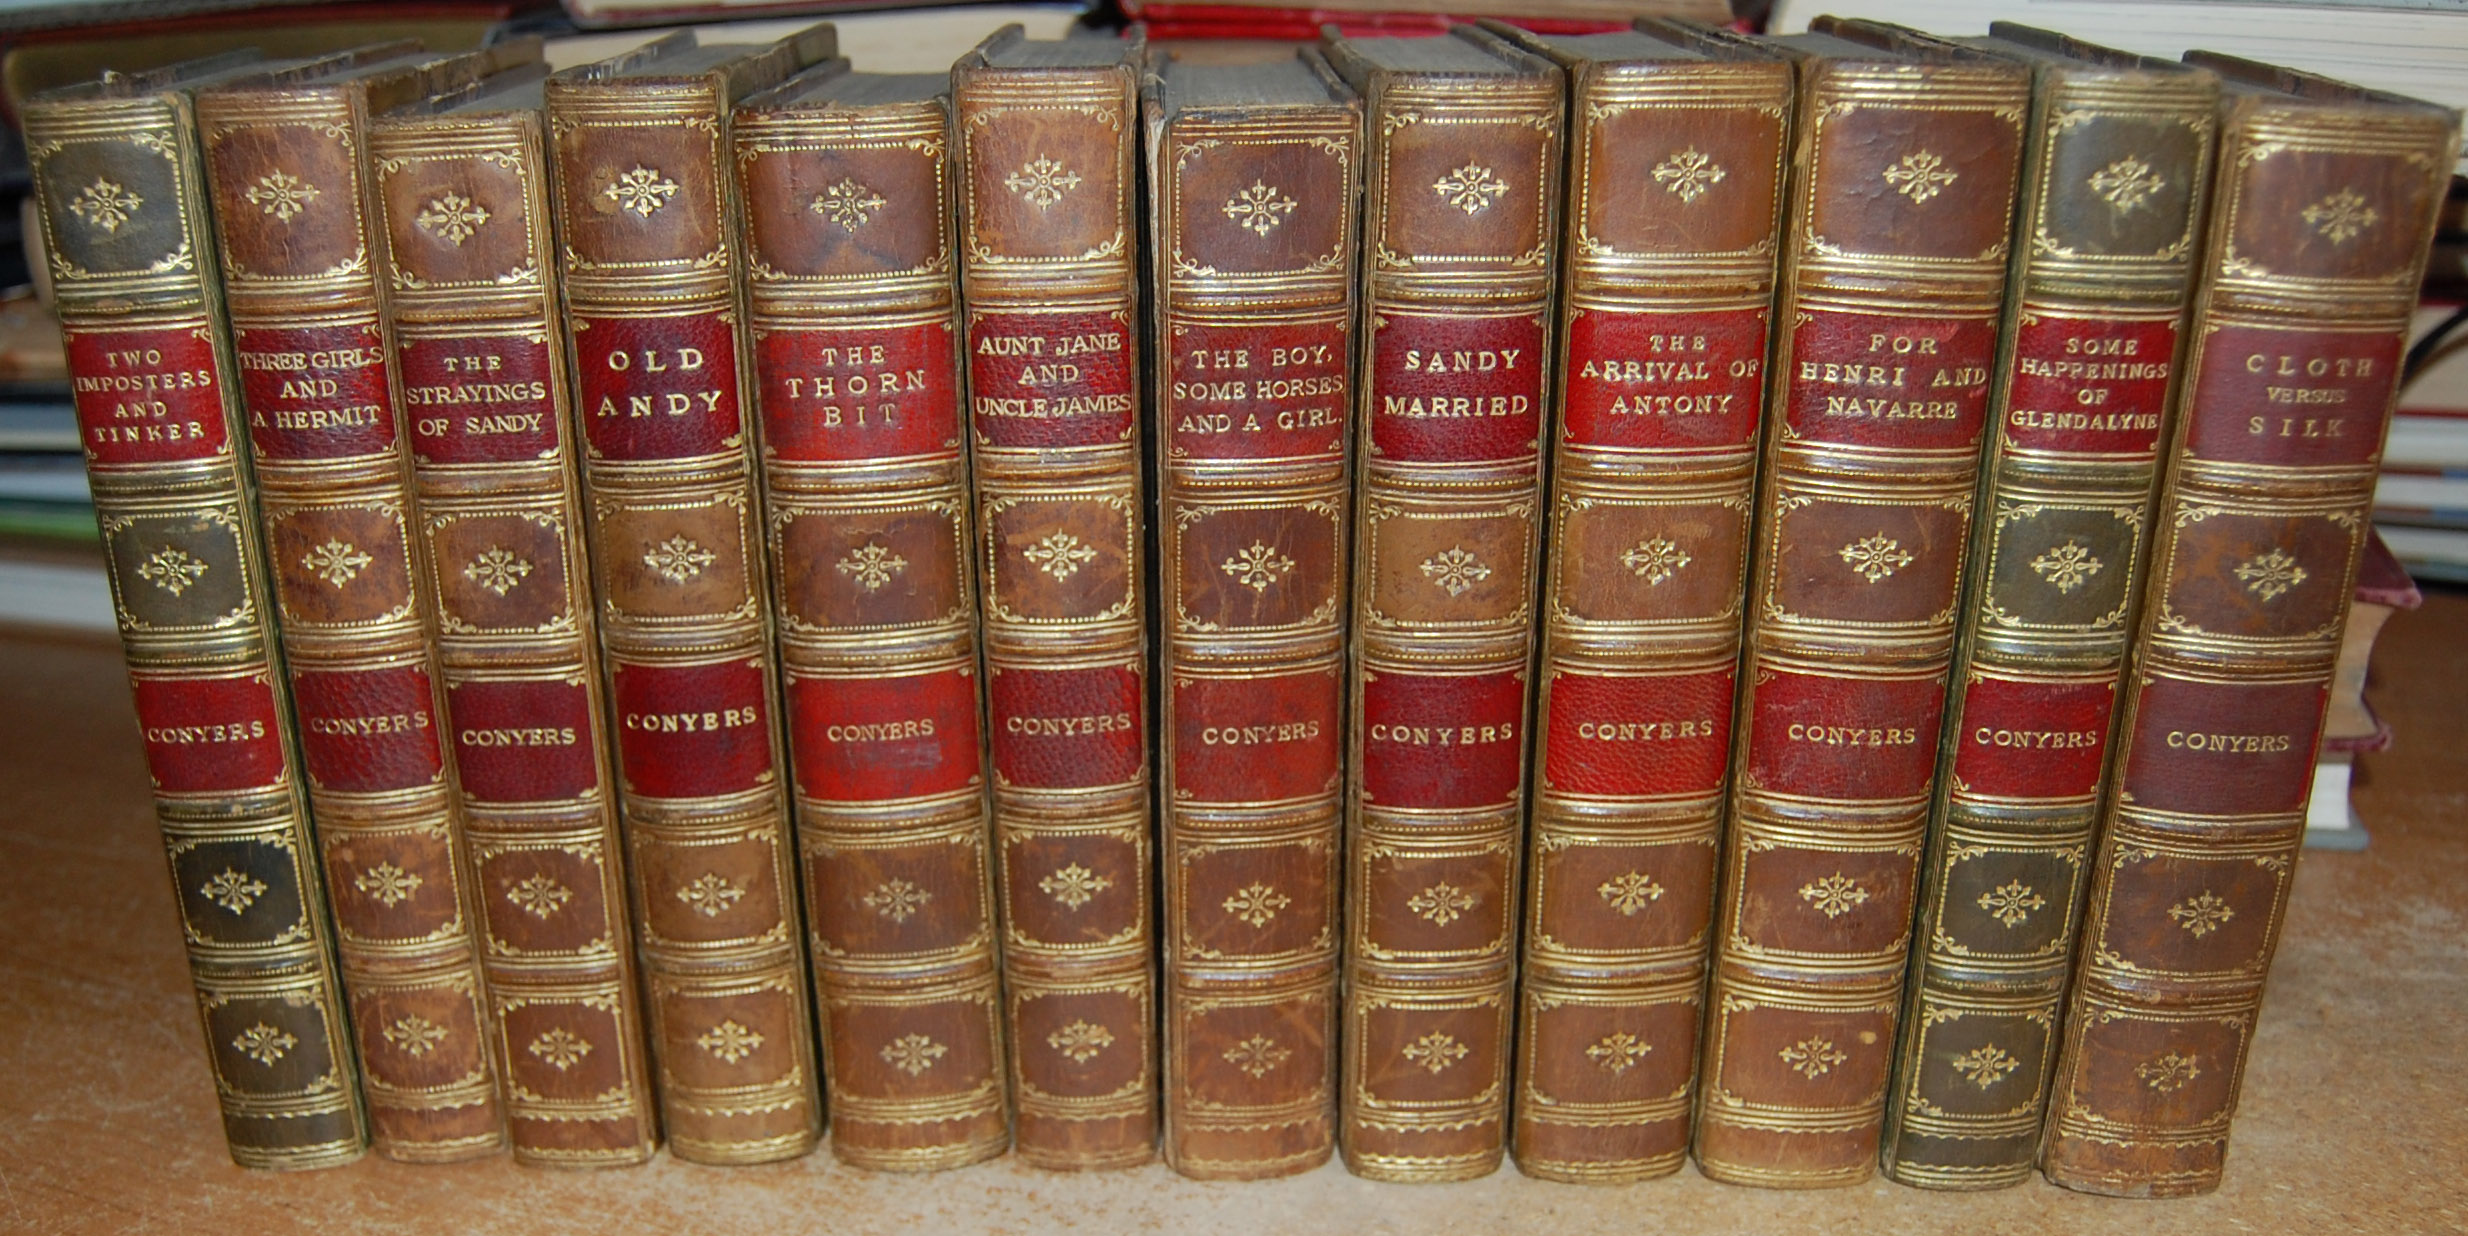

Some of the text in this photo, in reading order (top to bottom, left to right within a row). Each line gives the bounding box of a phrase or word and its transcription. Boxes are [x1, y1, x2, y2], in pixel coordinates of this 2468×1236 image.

[977, 333, 1121, 356] AUNT JANE
[1649, 335, 1706, 353] THE
[1868, 333, 1938, 355] FOR
[2065, 338, 2139, 356] SOME
[106, 349, 162, 369] TWO
[240, 346, 384, 371] THREE GIRLS
[444, 356, 502, 372] THE
[608, 347, 703, 372] OLD
[822, 345, 886, 367] THE
[1191, 345, 1333, 369] THE BOY,
[1404, 349, 1521, 372] SANDY
[2246, 354, 2374, 378] CLOTH
[1017, 364, 1079, 385] AND
[1580, 359, 1760, 383] ARRIVAL OF
[1801, 362, 1987, 386] HENRI AND
[2020, 358, 2168, 380] HAPPENINGS
[76, 370, 212, 392] IMPOSTERS
[280, 379, 338, 399] AND
[785, 370, 926, 398] THORN
[1173, 381, 1246, 400] SOME
[406, 381, 546, 405] STRAYINGS
[597, 390, 723, 418] ANDY
[1609, 394, 1733, 415] ANTONY
[2076, 388, 2109, 404] OF
[2266, 386, 2347, 404] VERSUS
[115, 401, 167, 418] AND
[253, 405, 381, 429] A HERMIT
[823, 403, 896, 428] BIT
[976, 394, 1131, 418] UNCLE JAMES
[1384, 395, 1529, 418] MARRIED
[1825, 396, 1958, 419] NAVARRE
[418, 413, 543, 436] OF SANDY
[1178, 407, 1342, 433] AND A GIRL.
[2010, 410, 2158, 431] GLENDALYNE
[2248, 416, 2344, 437] SILK
[95, 421, 205, 443] TINKER
[310, 711, 429, 736] CONYERS
[626, 706, 757, 733] CONYERS
[826, 718, 935, 744] CONYERS
[1006, 713, 1132, 737] CONYERS
[1578, 720, 1714, 741] CONYERS
[148, 720, 265, 744] CONYERS
[462, 728, 577, 747] CONYERS
[1202, 720, 1320, 746] CONYERS
[1371, 723, 1513, 746] CONYERS
[1787, 723, 1916, 747] CONYERS
[1975, 727, 2097, 750] CONYERS
[2167, 731, 2290, 753] CONYERS
